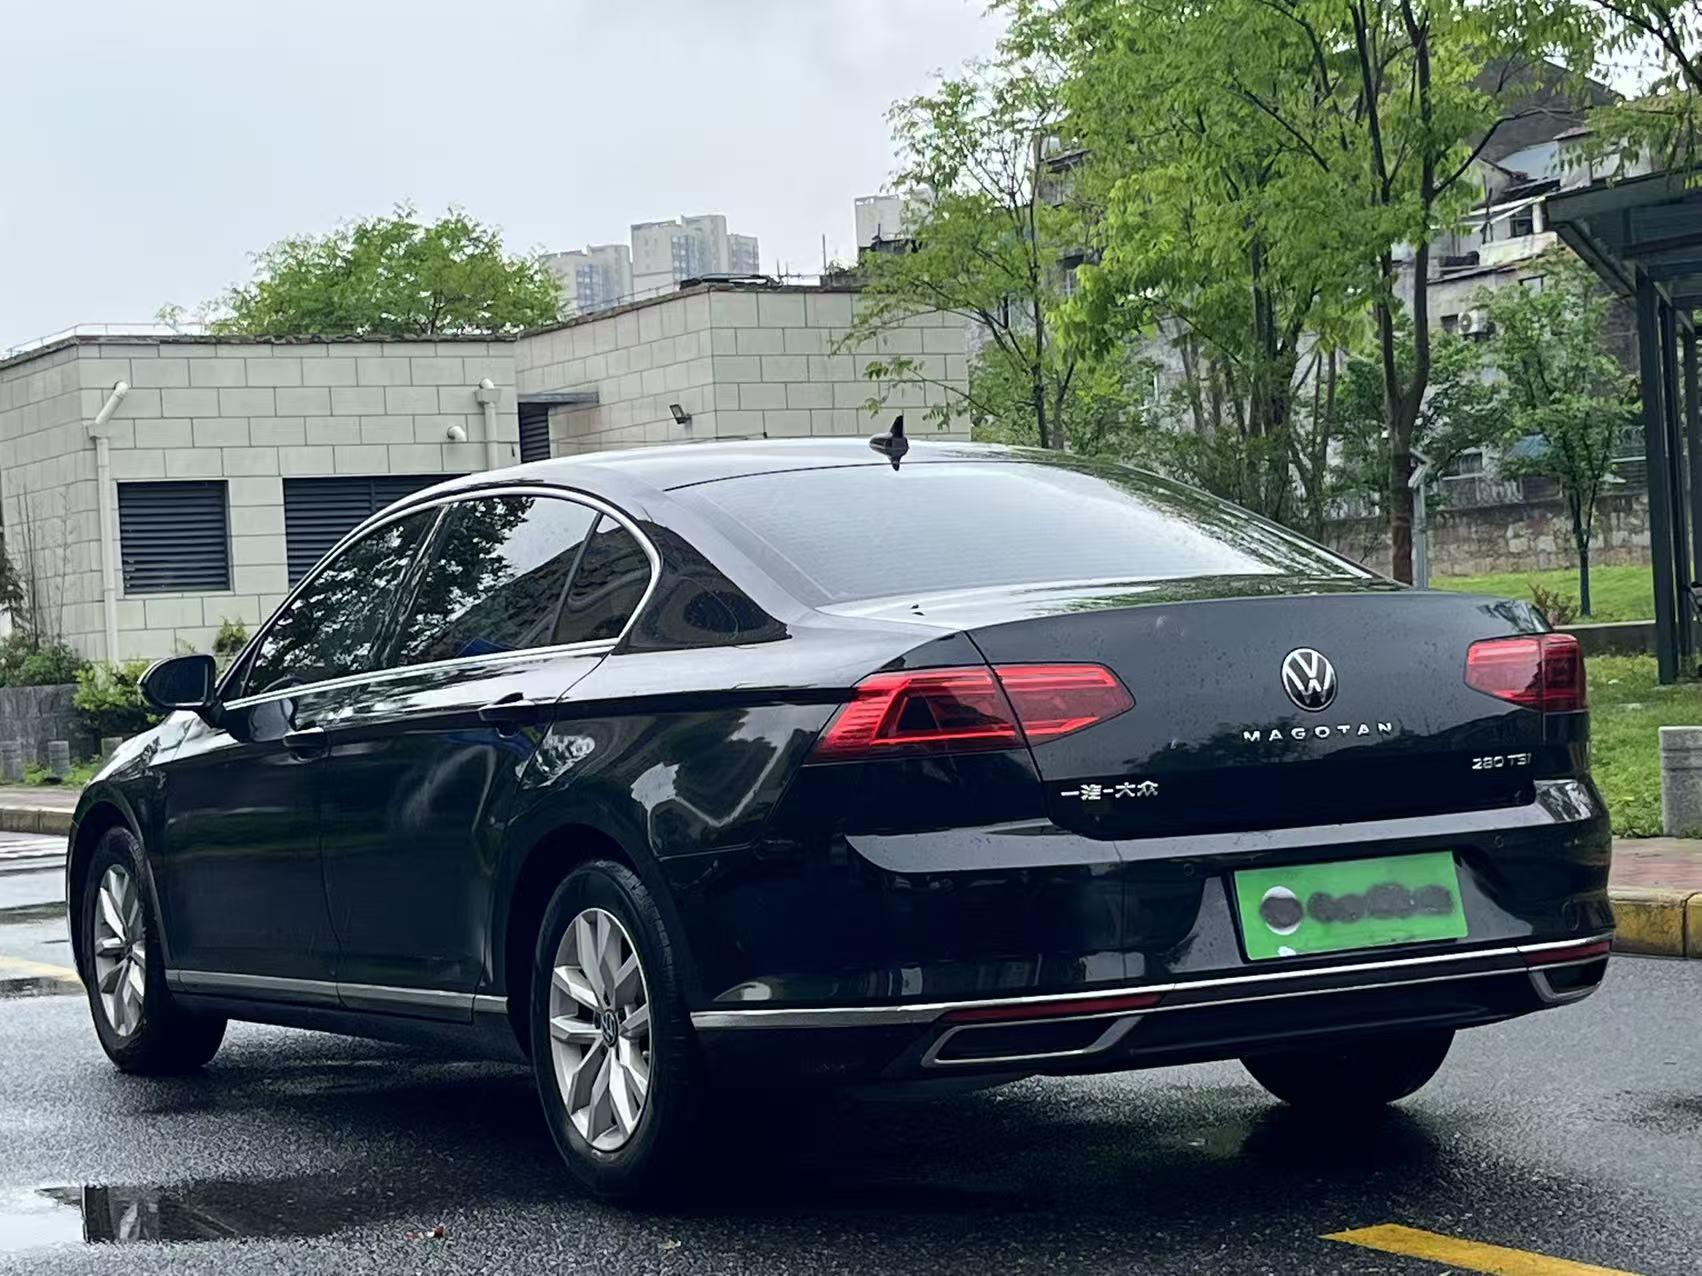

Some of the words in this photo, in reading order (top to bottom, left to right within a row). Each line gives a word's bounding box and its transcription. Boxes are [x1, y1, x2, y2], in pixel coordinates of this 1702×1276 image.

[1243, 722, 1392, 742] MAGOTAN
[1472, 756, 1505, 770] 280
[1507, 752, 1532, 767] TSI
